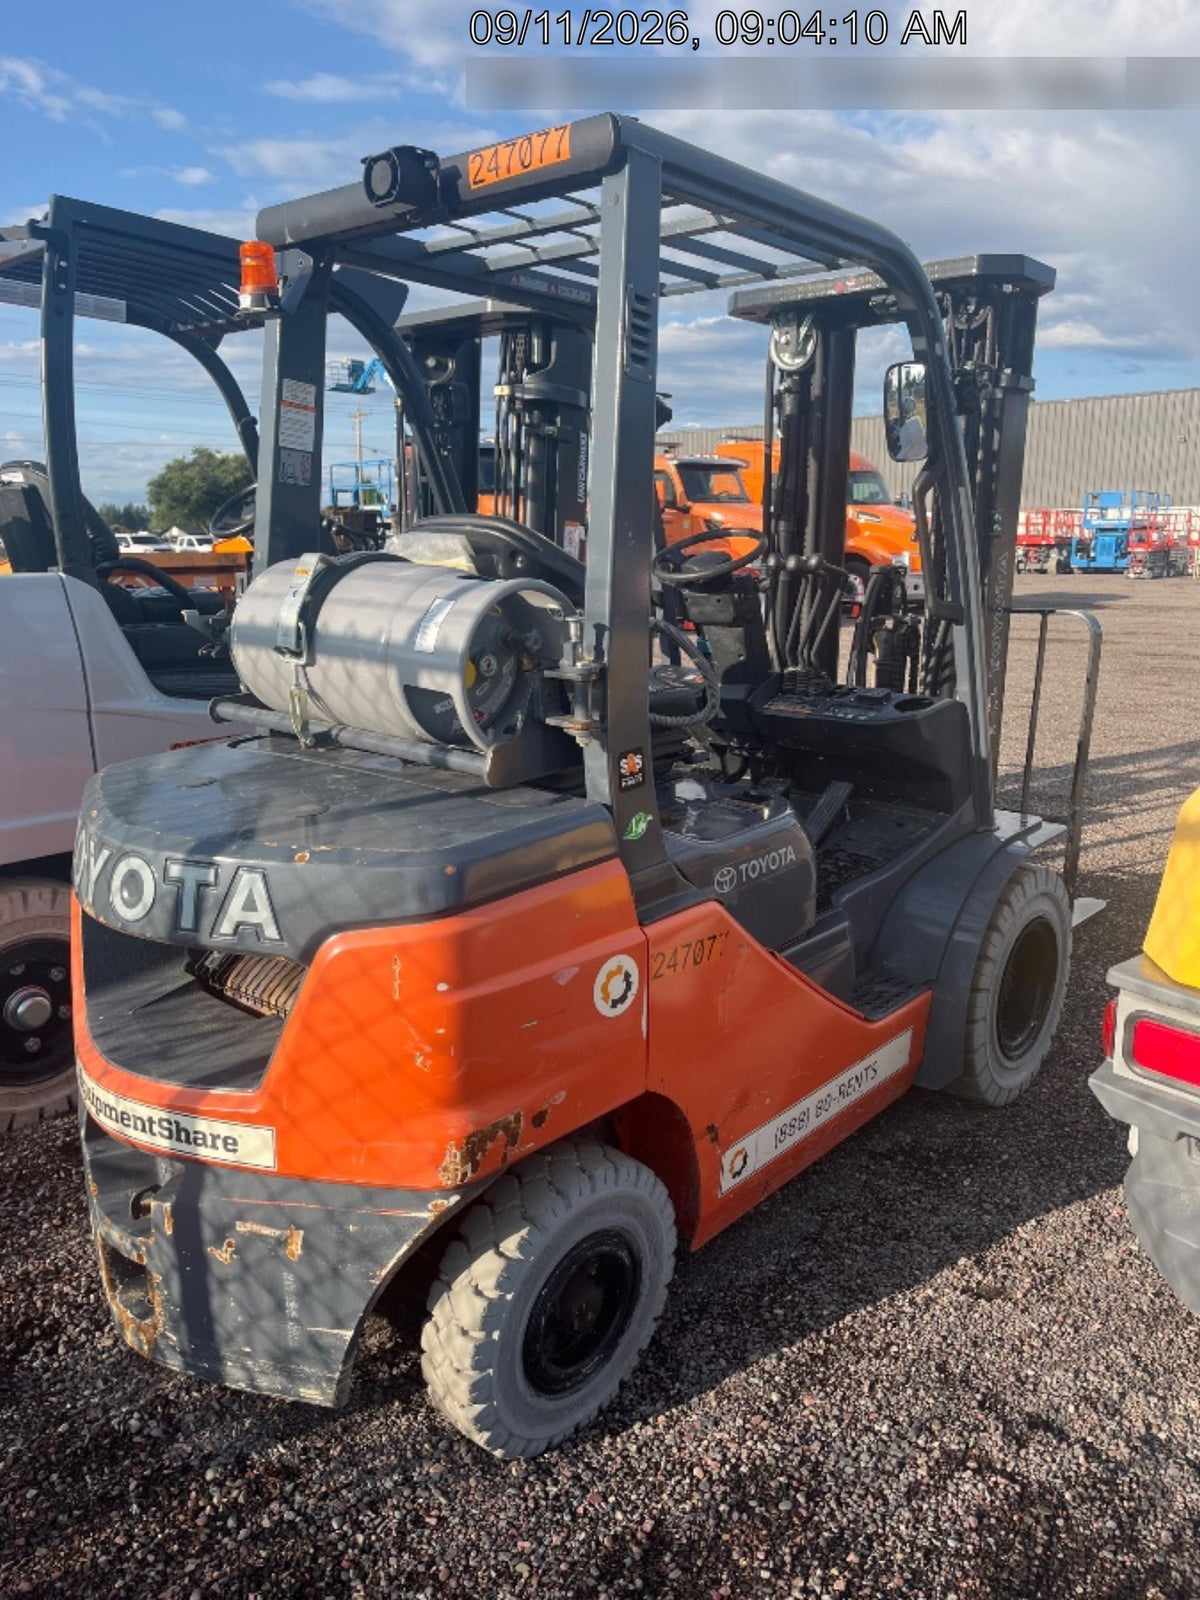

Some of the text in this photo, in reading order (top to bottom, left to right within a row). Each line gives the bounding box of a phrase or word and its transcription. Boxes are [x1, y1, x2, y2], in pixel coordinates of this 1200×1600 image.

[470, 124, 569, 185] 247077
[74, 828, 284, 943] OYOTA
[739, 845, 796, 883] TOYOTA
[815, 1061, 878, 1119] 80-RENTS
